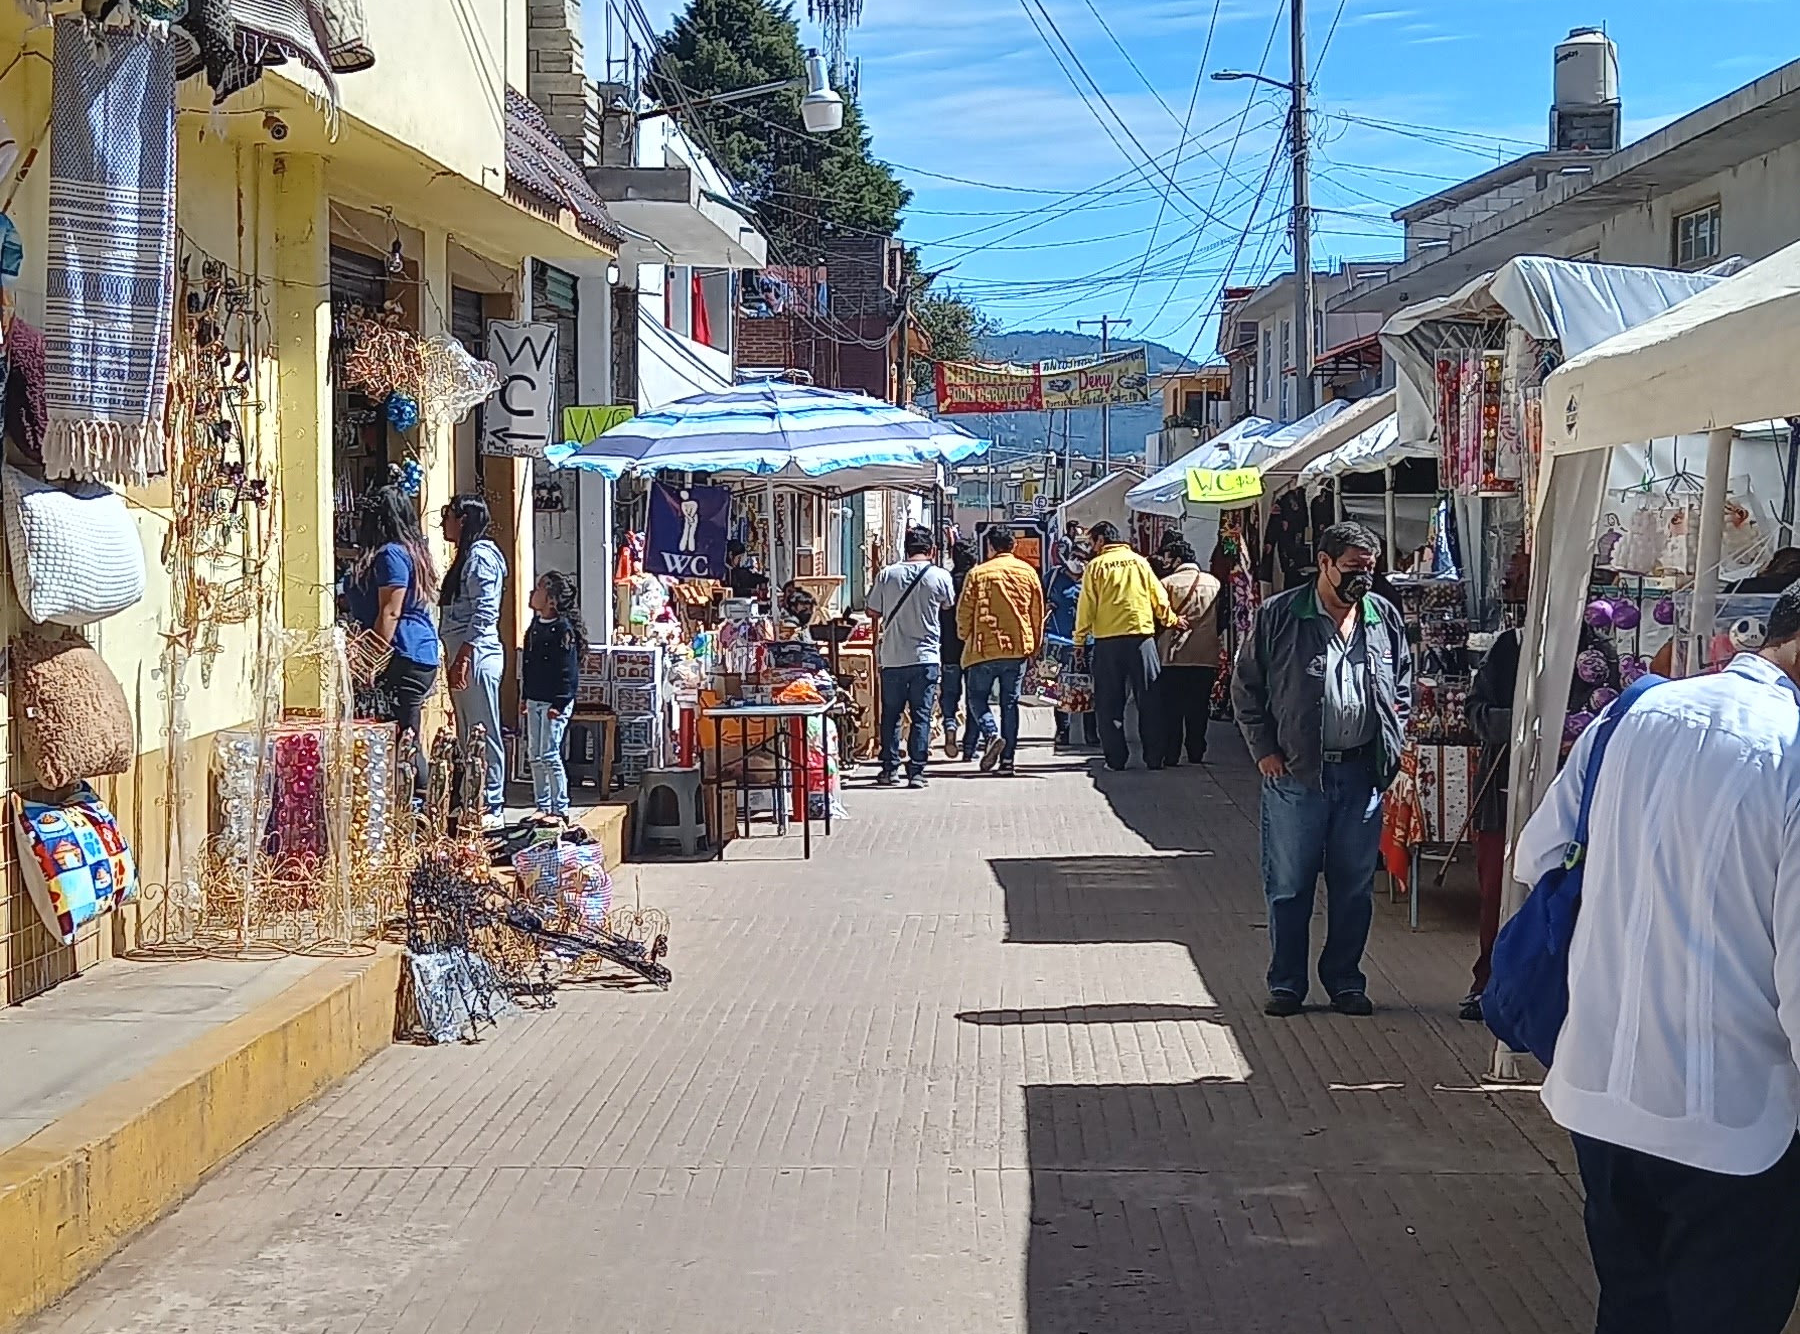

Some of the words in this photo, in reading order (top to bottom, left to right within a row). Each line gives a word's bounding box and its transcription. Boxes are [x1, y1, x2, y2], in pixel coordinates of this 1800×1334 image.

[1079, 370, 1114, 394] Deny
[1192, 469, 1235, 491] WC
[660, 551, 709, 576] WC
